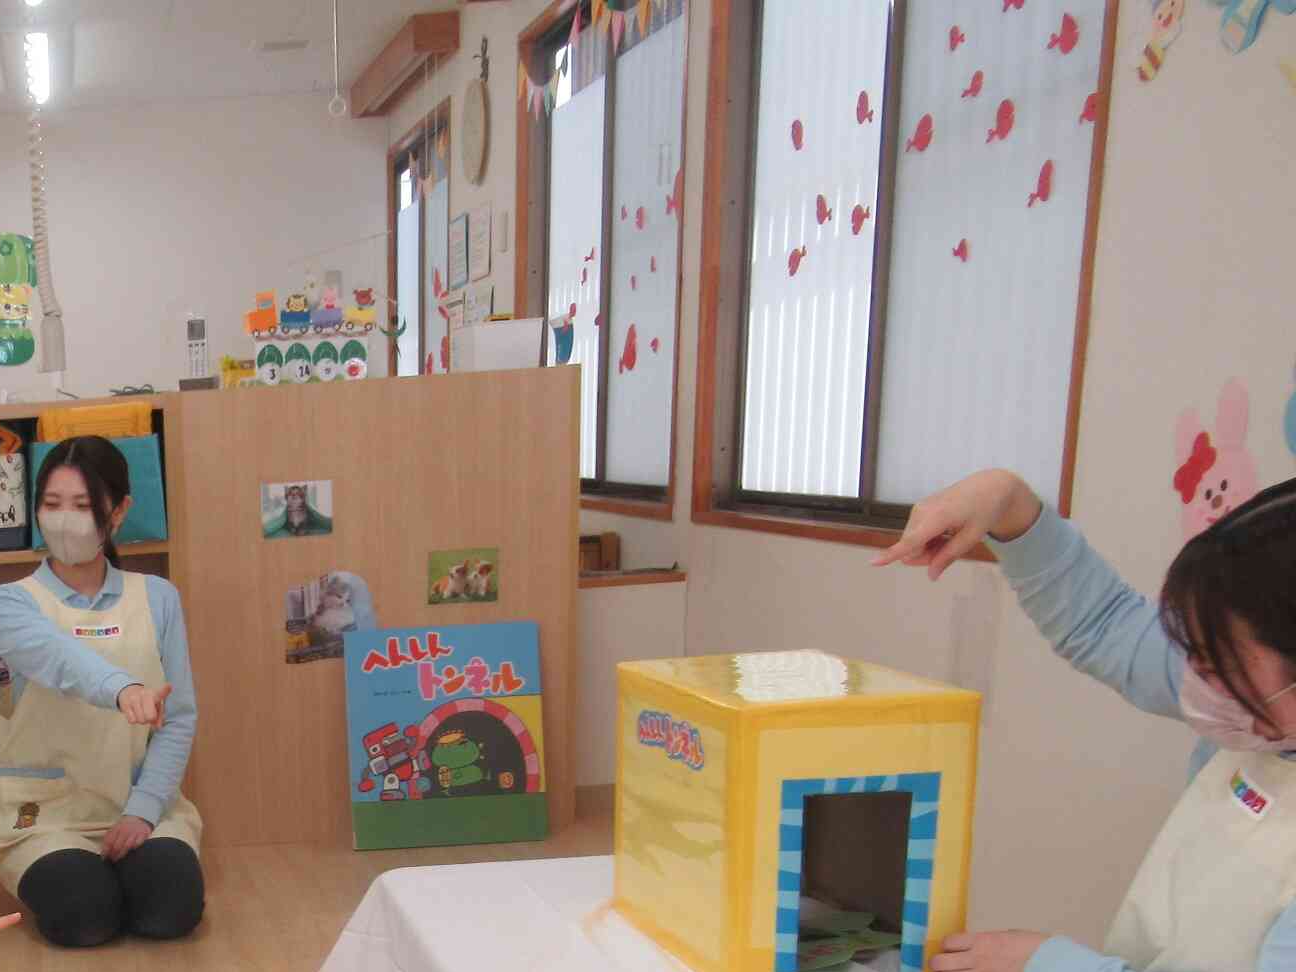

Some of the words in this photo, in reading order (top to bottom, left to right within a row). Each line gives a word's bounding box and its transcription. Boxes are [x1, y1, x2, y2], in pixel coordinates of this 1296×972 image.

[361, 632, 453, 673] へんしん
[418, 656, 526, 700] トンネル
